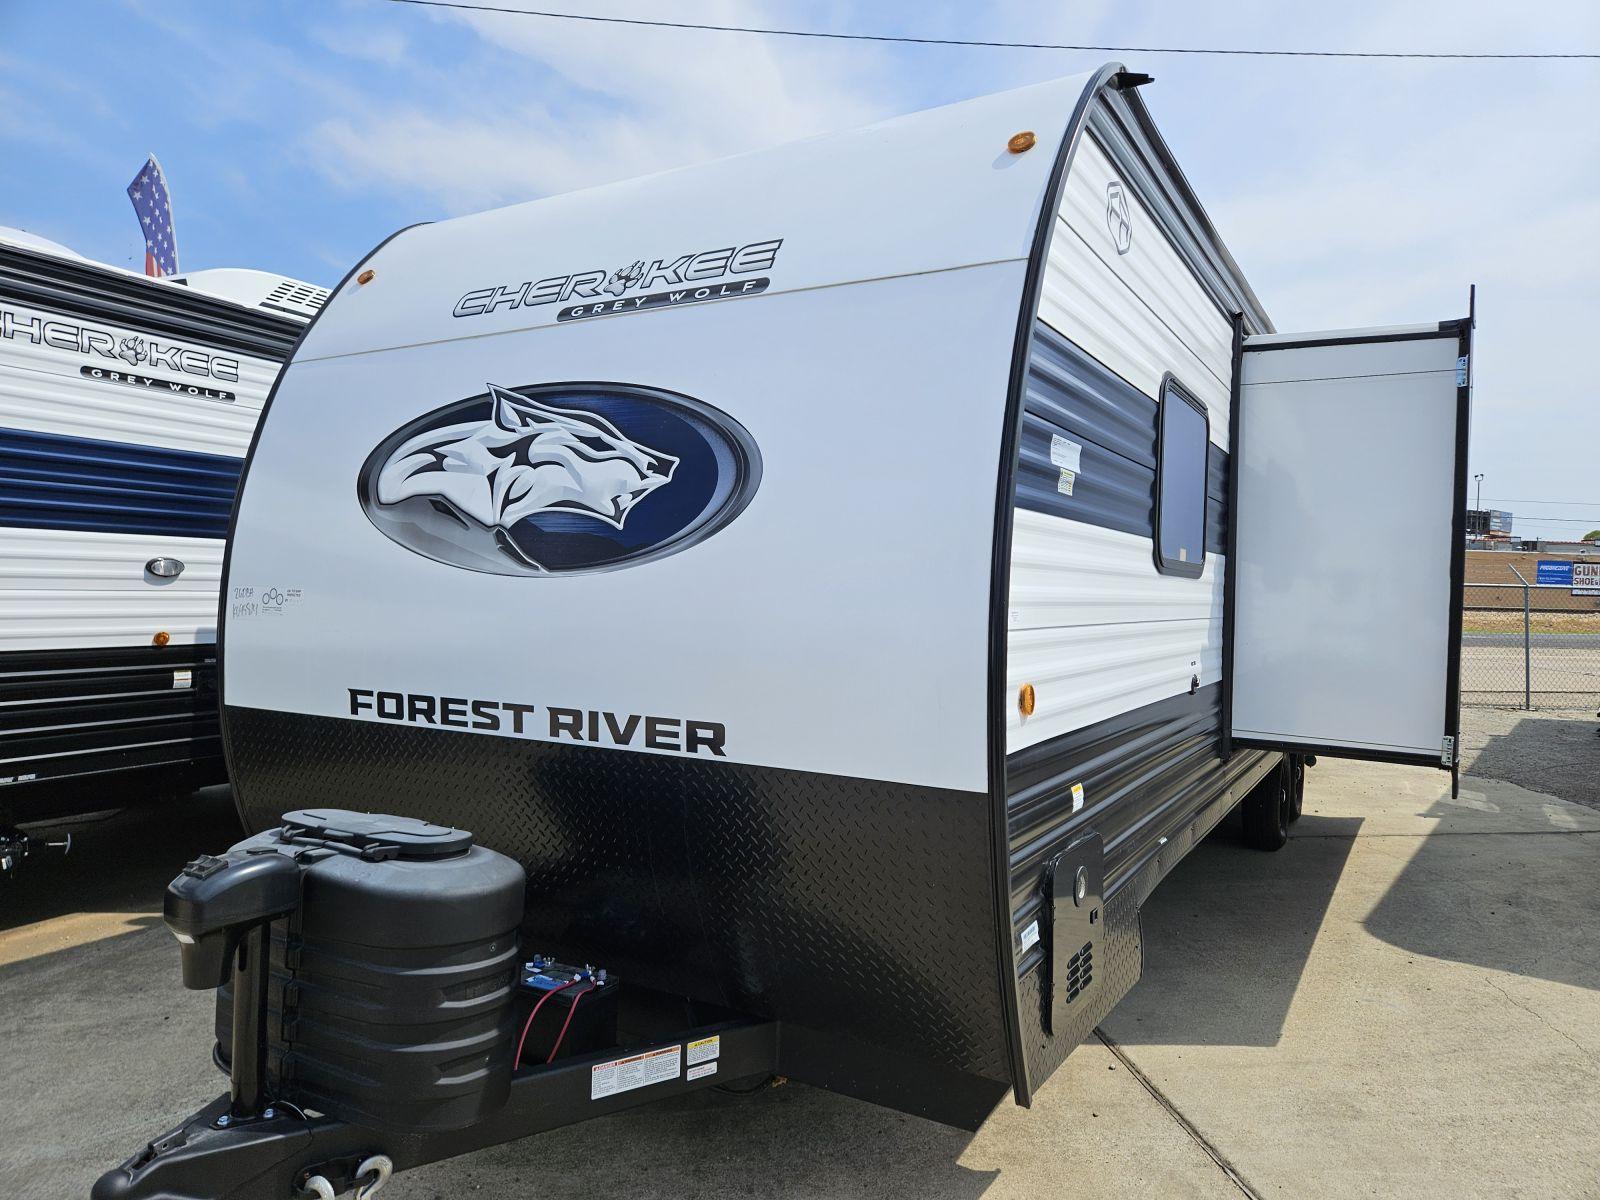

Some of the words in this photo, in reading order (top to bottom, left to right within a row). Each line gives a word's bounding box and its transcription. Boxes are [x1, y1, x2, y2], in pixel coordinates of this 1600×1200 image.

[571, 296, 648, 317] GREY
[669, 280, 757, 303] WOLF
[0, 310, 239, 382] HEROKEE
[91, 368, 153, 387] GREY
[169, 382, 227, 400] WOLF
[347, 687, 535, 734] FOREST
[546, 706, 727, 757] RIVER
